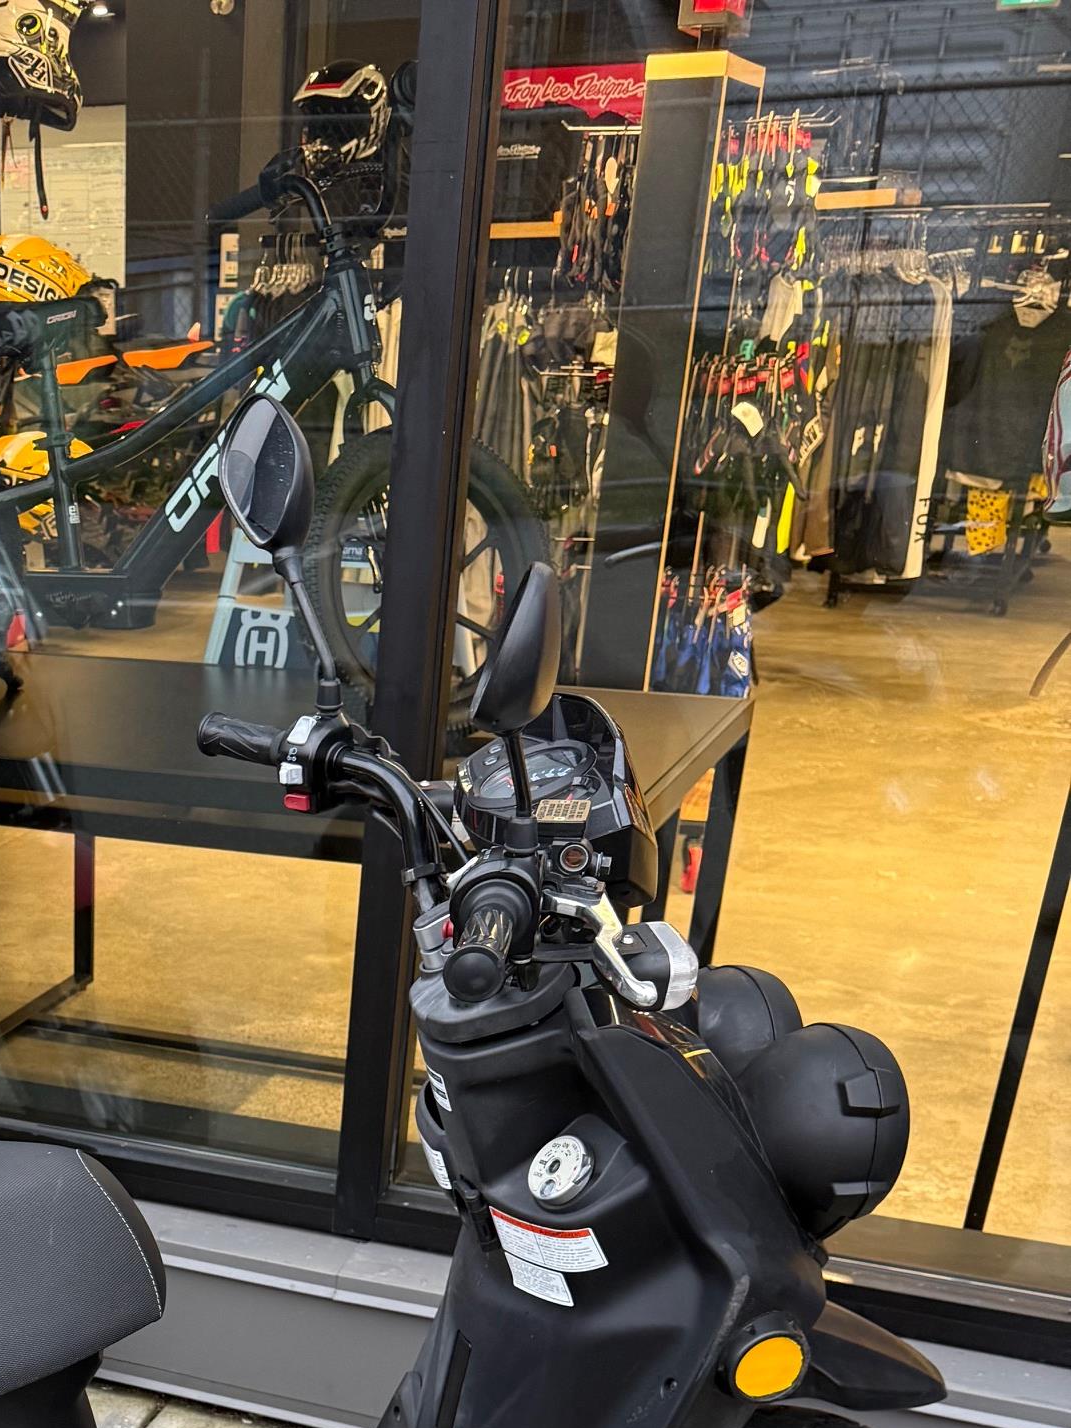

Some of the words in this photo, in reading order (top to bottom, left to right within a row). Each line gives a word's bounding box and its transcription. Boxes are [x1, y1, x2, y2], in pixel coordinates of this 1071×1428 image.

[505, 77, 541, 108] Troy
[540, 75, 572, 101] Lee
[573, 73, 647, 108] Designs
